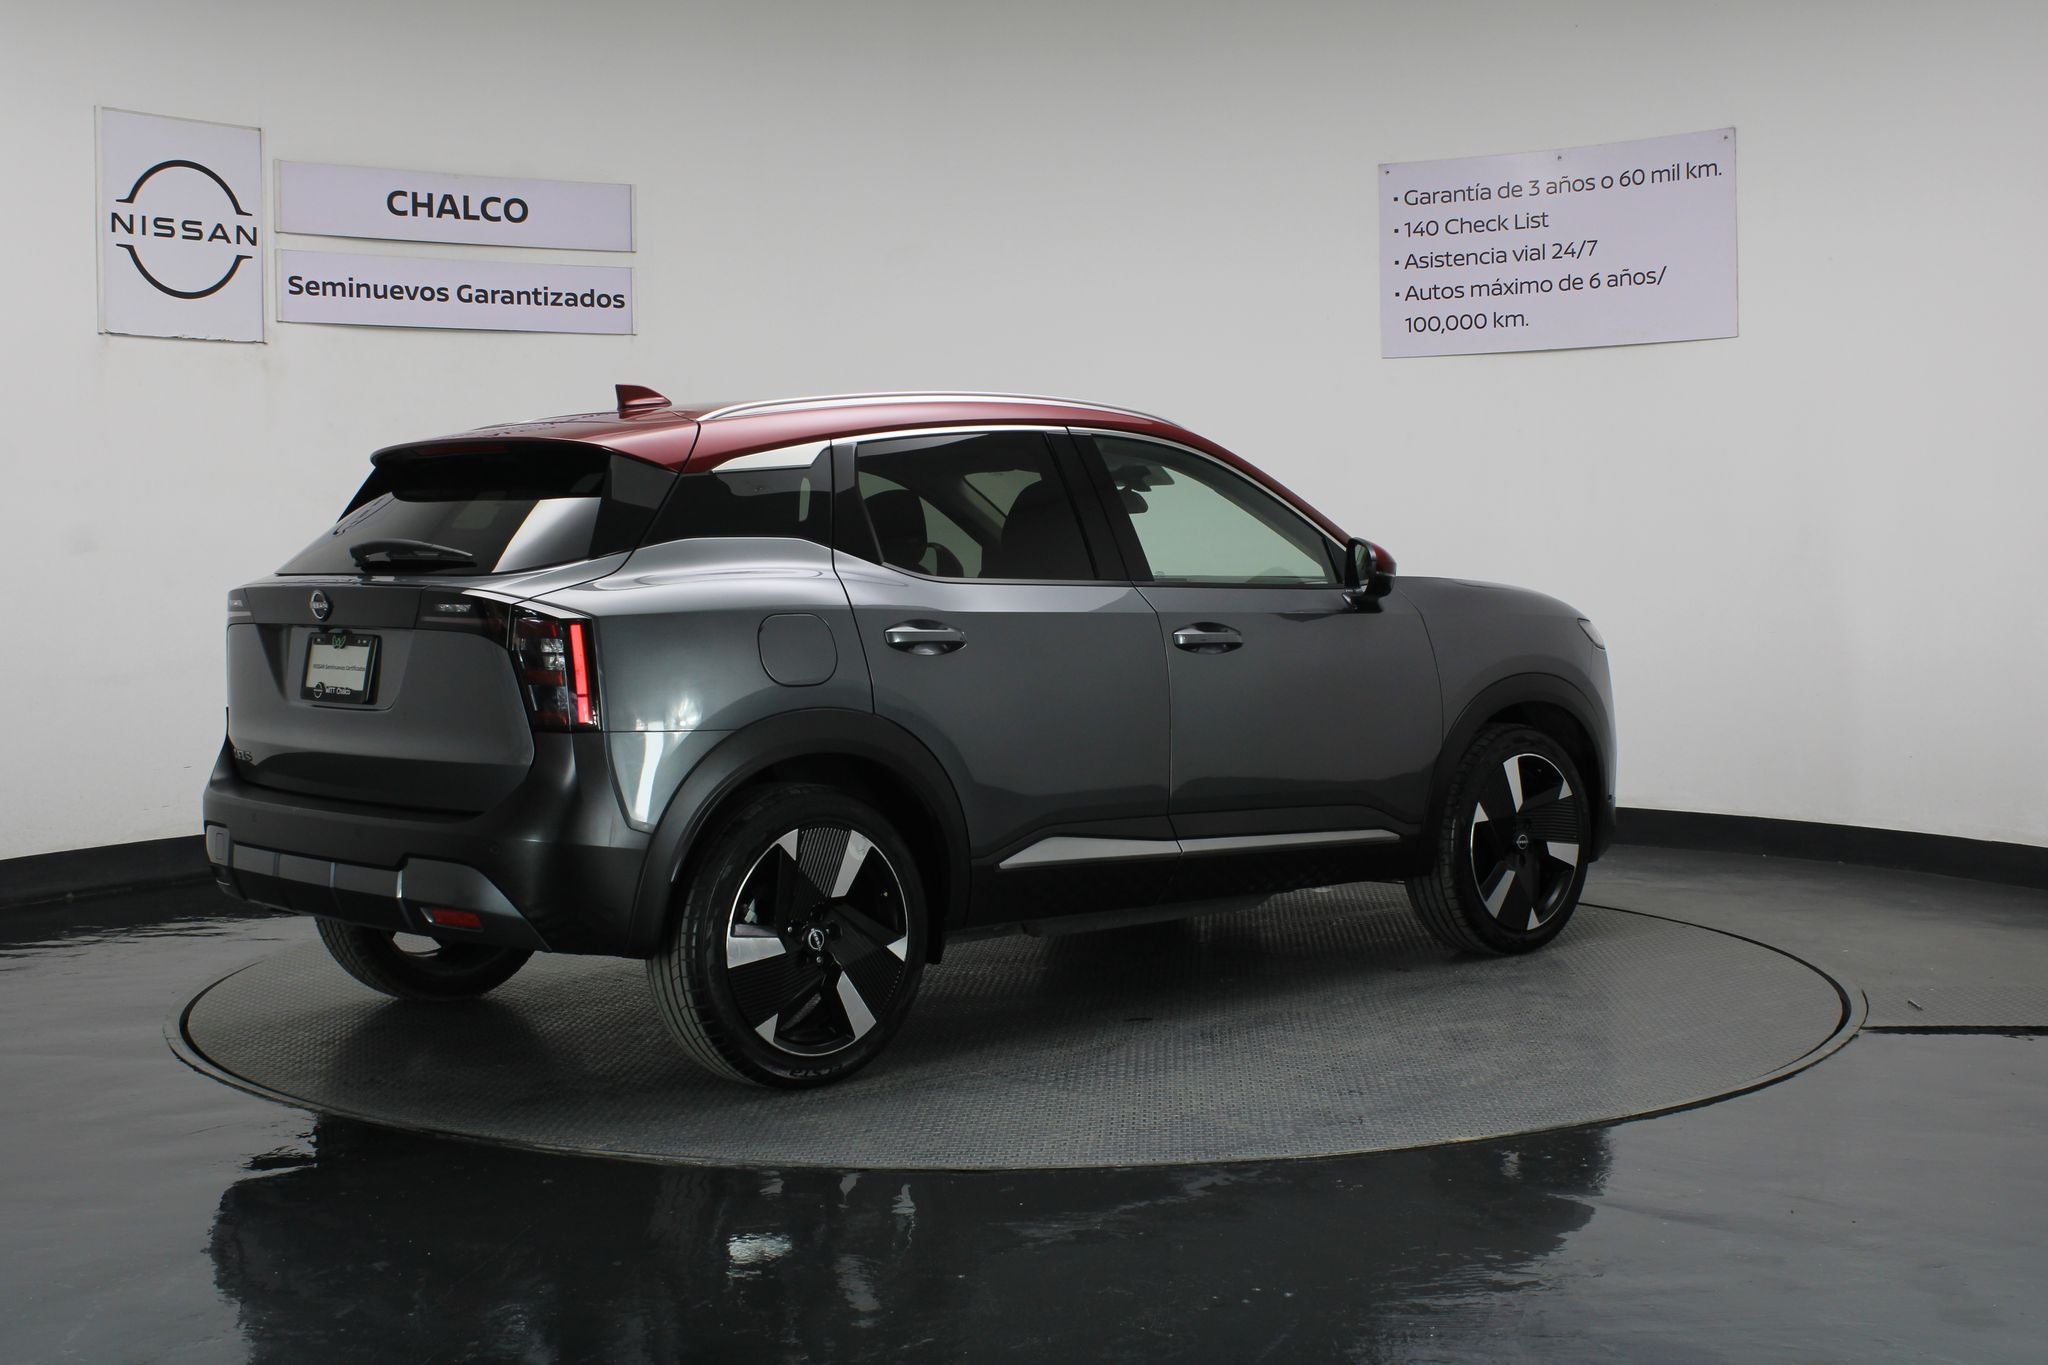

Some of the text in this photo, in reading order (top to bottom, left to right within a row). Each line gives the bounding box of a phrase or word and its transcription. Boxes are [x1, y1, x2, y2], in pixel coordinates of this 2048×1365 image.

[1403, 161, 1723, 206] Garantía de 3 años o 60 mil km.
[386, 190, 529, 224] CHALCO
[111, 212, 257, 247] NISSAN
[1404, 211, 1550, 238] 140 Check List
[1404, 239, 1599, 270] Asistencia vial 24/7
[288, 275, 626, 309] Seminuevos Garantizados
[1404, 265, 1667, 302] Autos máximo de 6 años/
[1404, 311, 1530, 335] 100,000 km.
